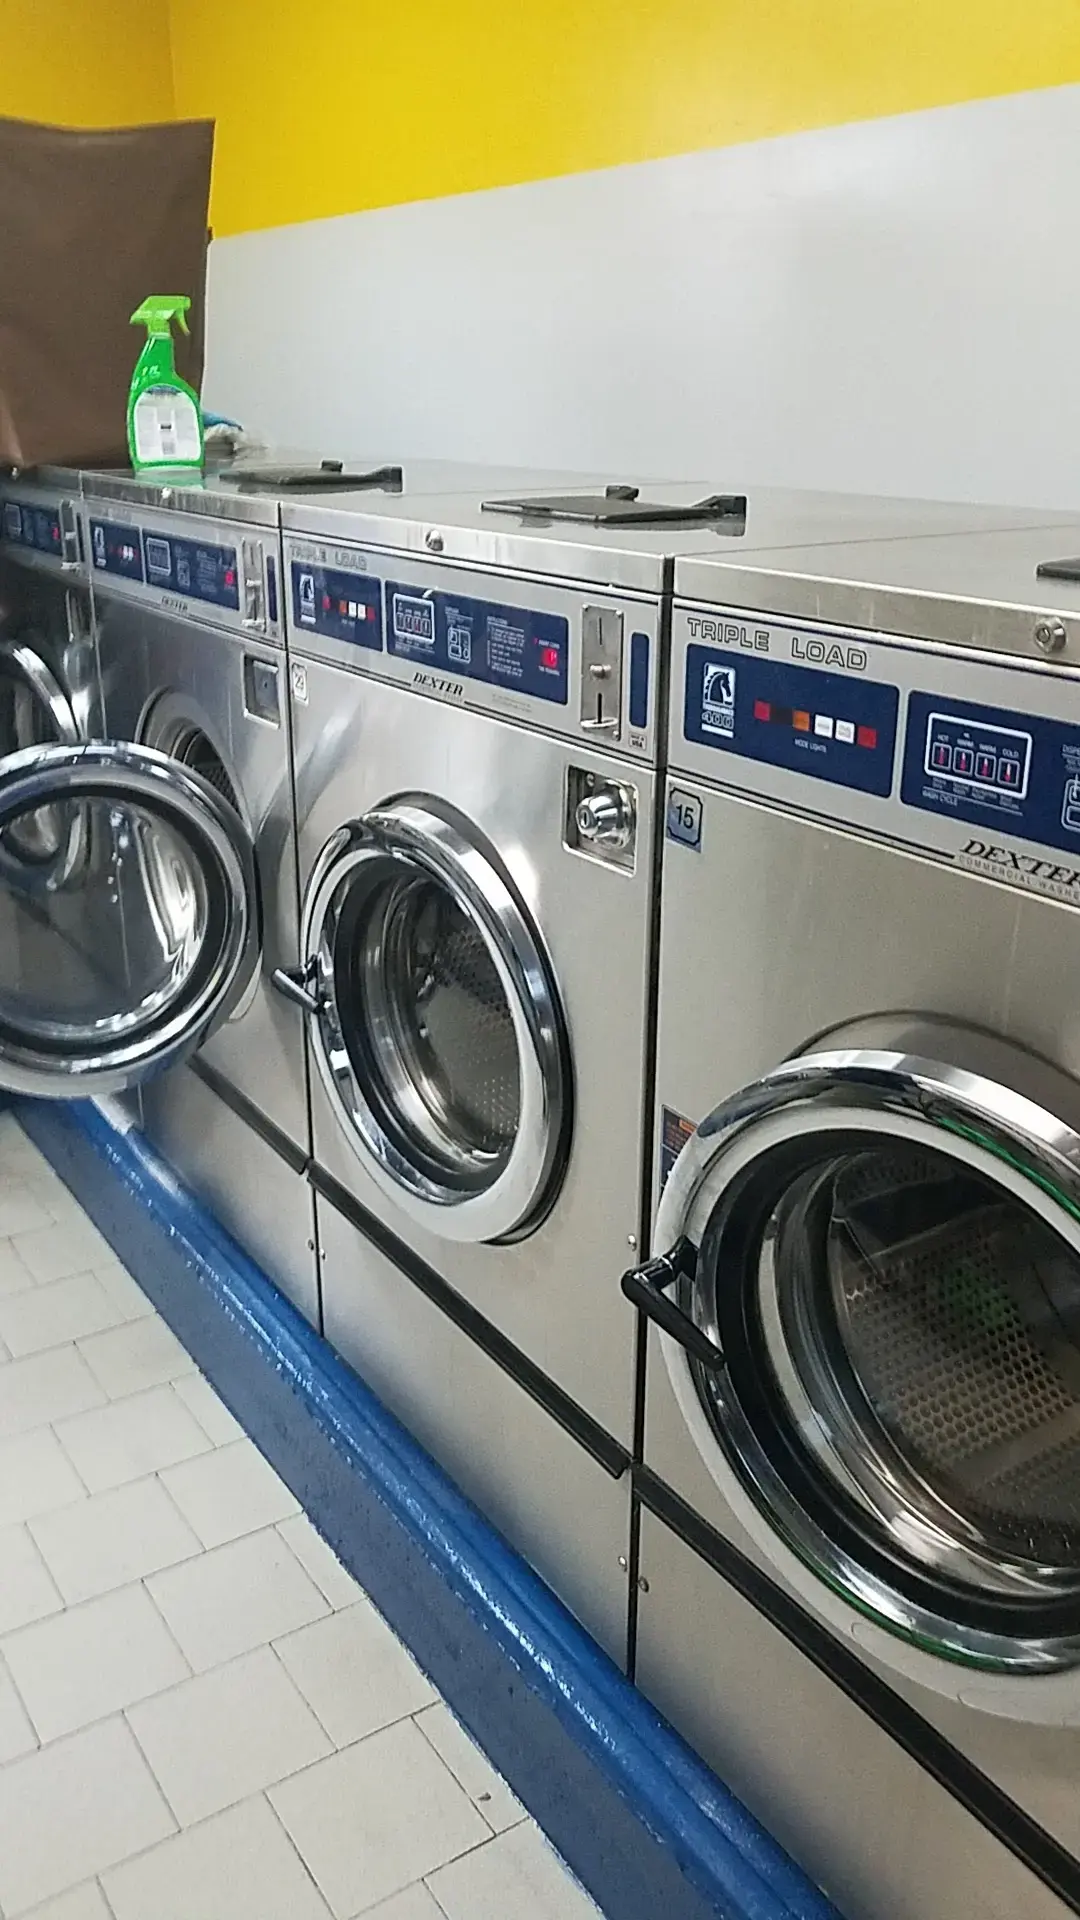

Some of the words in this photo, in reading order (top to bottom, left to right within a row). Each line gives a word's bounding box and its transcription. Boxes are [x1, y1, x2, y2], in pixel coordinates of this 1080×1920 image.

[335, 551, 368, 571] LOAD
[687, 617, 770, 652] TRIPLE
[791, 637, 867, 671] LOAD
[413, 672, 463, 696] DEXTER
[701, 710, 734, 729] 400
[1002, 747, 1019, 759] COLD
[675, 803, 694, 829] 15
[959, 854, 1031, 884] COMMERCIAL
